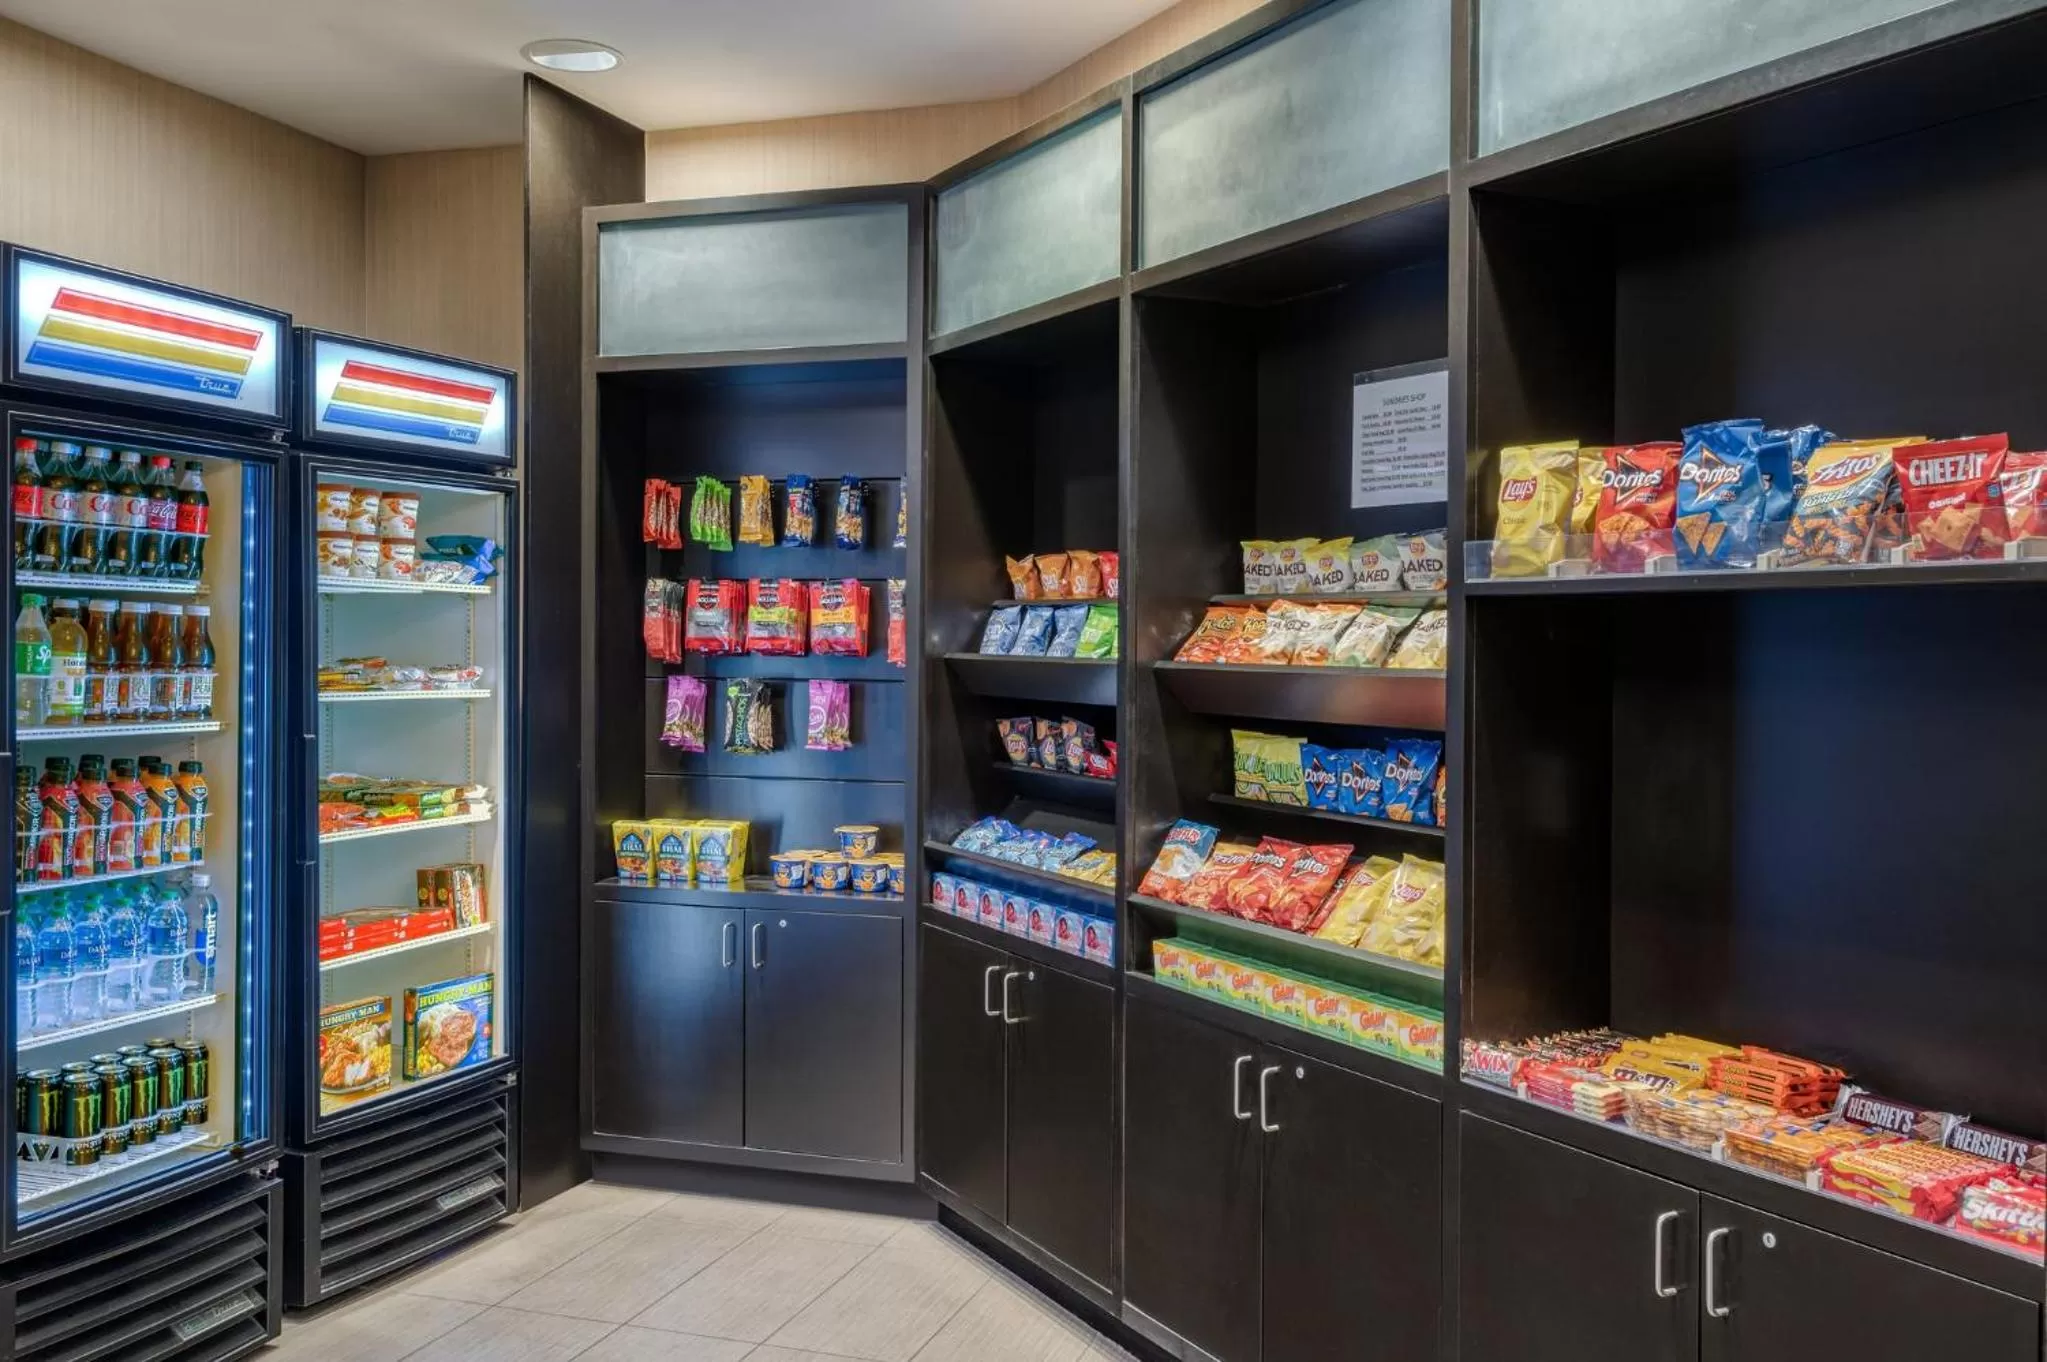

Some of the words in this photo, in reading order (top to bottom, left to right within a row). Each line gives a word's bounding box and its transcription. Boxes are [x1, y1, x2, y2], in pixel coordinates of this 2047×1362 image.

[1601, 468, 1664, 488] Doritos
[1679, 462, 1744, 485] Doritos
[1808, 453, 1881, 485] Fritos
[1502, 476, 1537, 503] Lay's
[1244, 563, 1273, 577] AKED
[1341, 772, 1382, 792] Doritos
[1385, 763, 1424, 781] Doritos
[1846, 1096, 1915, 1133] HERSHEY'S
[1952, 1126, 2030, 1166] HERSHEY'S
